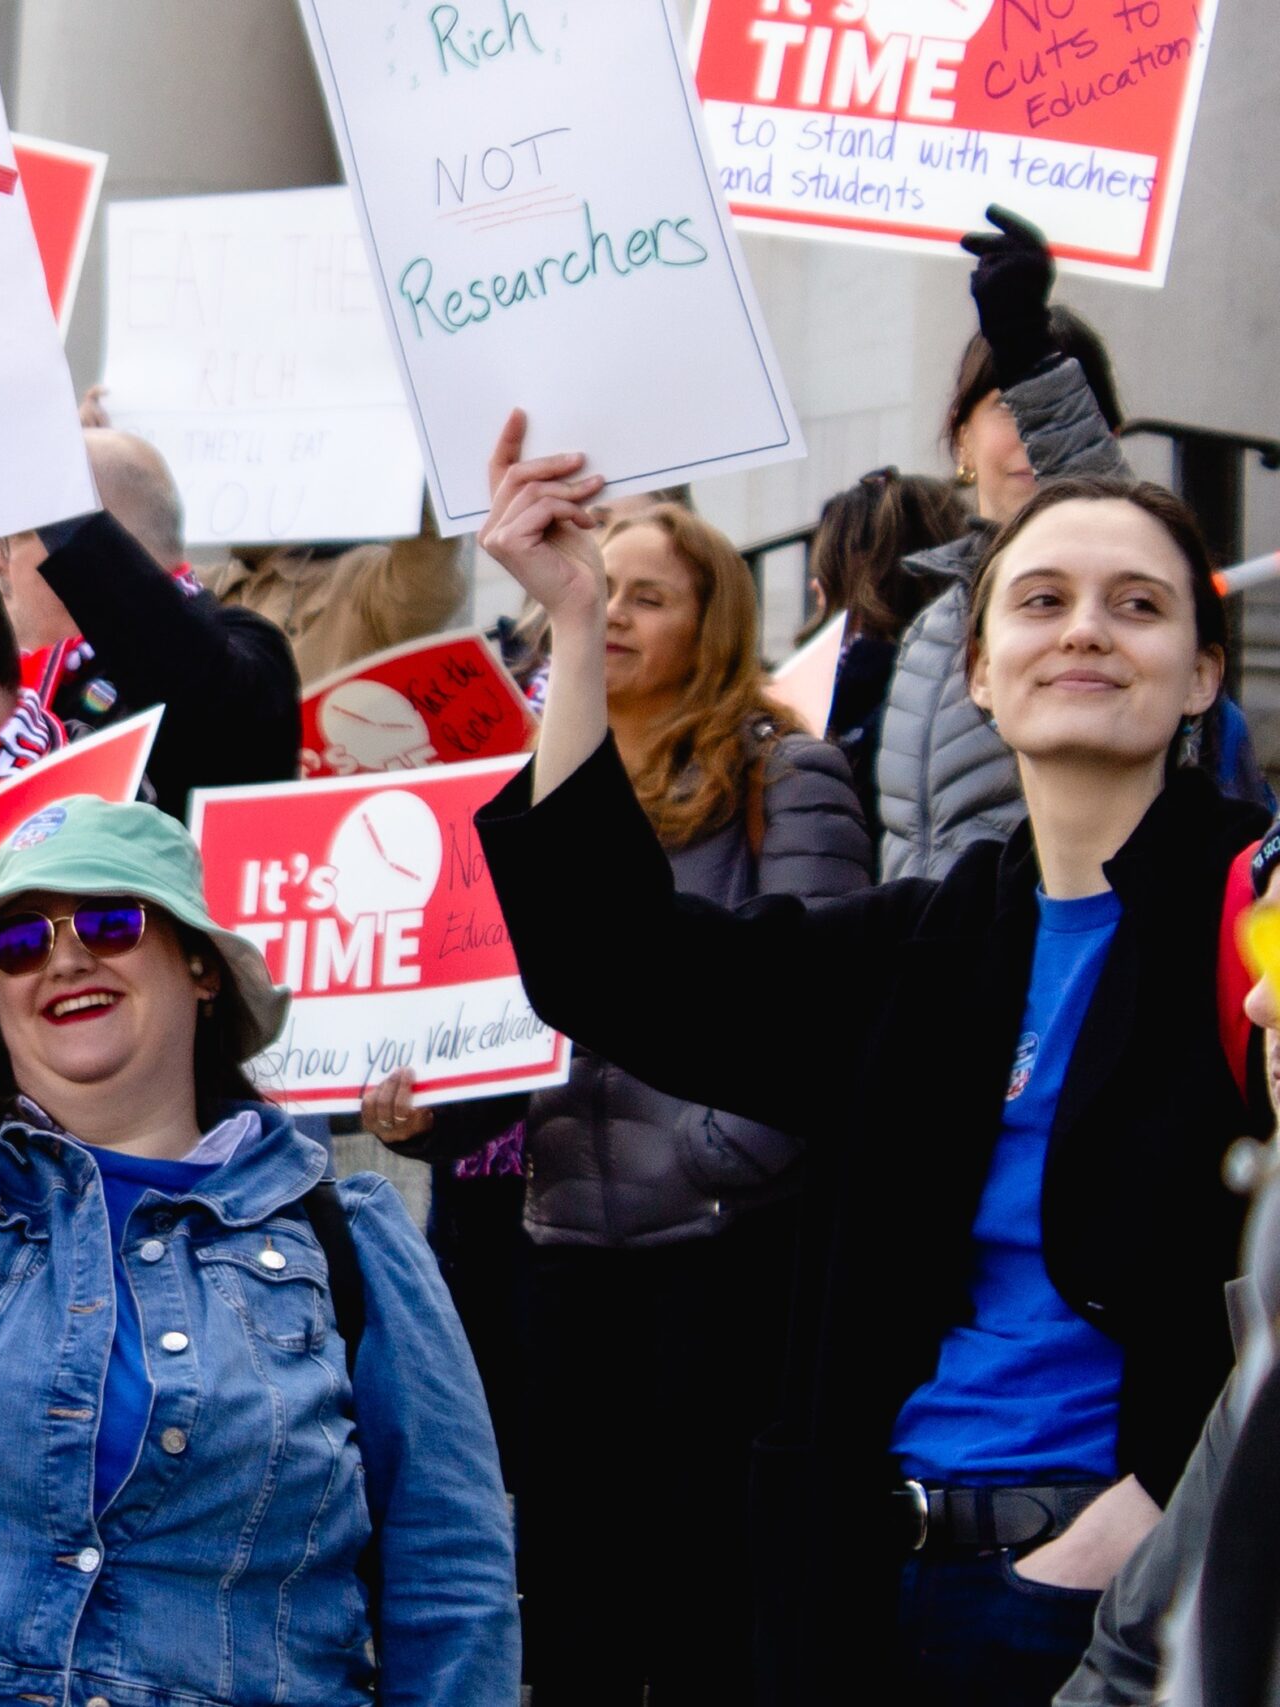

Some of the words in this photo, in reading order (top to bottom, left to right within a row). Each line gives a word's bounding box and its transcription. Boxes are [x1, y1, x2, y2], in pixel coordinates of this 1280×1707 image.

[429, 0, 544, 73] Rich
[1113, 0, 1161, 33] to
[748, 18, 967, 121] TIME
[437, 127, 571, 206] NOT
[721, 154, 772, 196] and
[791, 162, 925, 212] students
[731, 105, 776, 147] to
[918, 128, 988, 175] with
[1009, 140, 1157, 202] teachers
[128, 227, 235, 329] EAT
[280, 232, 372, 313] THE
[399, 199, 709, 338] Researchers
[196, 348, 298, 407] RICH
[289, 429, 332, 464] EAT
[210, 480, 308, 536] OU
[449, 805, 484, 891] No
[241, 852, 340, 916] It's
[234, 907, 424, 993] TIME
[439, 908, 511, 960] Educa
[358, 1036, 414, 1100] you
